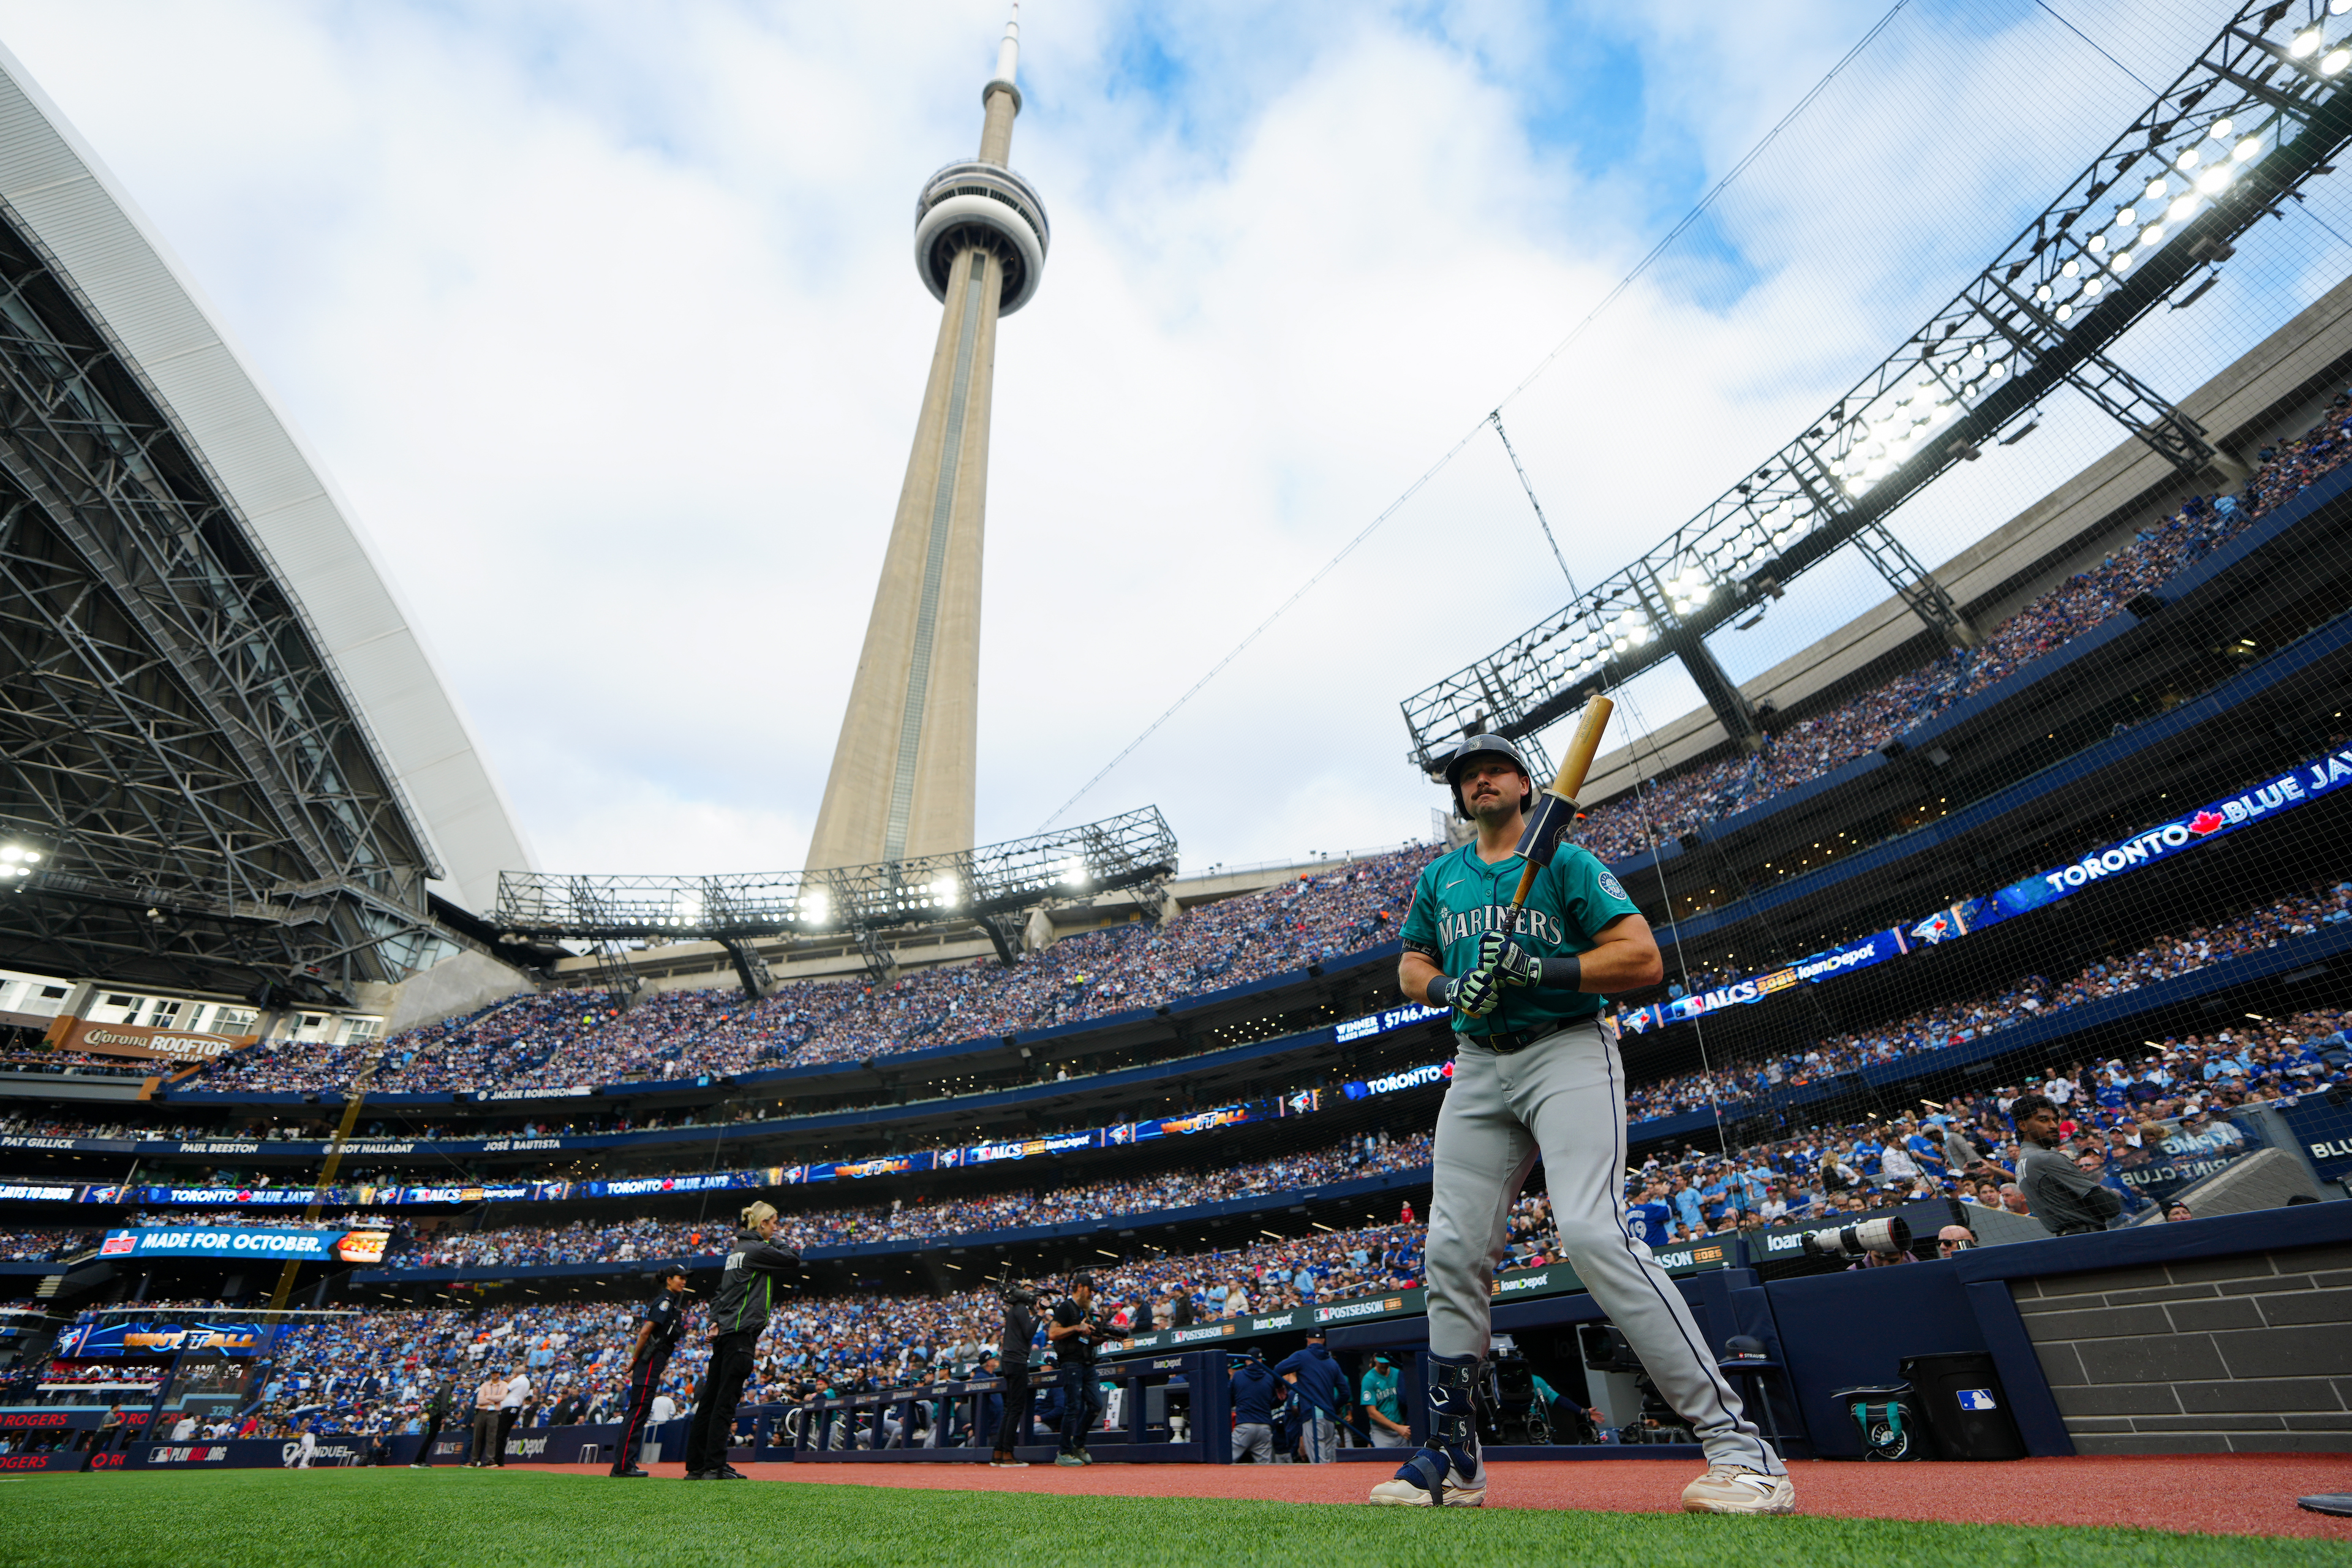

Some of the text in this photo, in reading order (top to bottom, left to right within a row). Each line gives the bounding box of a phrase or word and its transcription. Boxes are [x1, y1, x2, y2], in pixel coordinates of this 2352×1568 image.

[2046, 824, 2189, 893] TORONTO
[2222, 775, 2305, 824] BLUE
[1437, 904, 1563, 952] MARINERS
[1504, 944, 1518, 968] Franklin
[1705, 943, 1875, 1011] ALCS 2025 loanDepot
[1335, 1016, 1379, 1035] WINNER
[1336, 1025, 1379, 1043] TAKES HOME
[83, 1028, 149, 1047] Corona
[149, 1035, 231, 1057] ROOFTOP
[1366, 1066, 1441, 1095] TORONTO
[490, 1090, 524, 1101] JACKIE
[524, 1087, 572, 1099] ROBINSON
[1, 1136, 76, 1149] PAT GILLICK
[179, 1143, 258, 1153] PAUL BEESTON
[338, 1144, 360, 1153] ROY
[361, 1144, 415, 1154] HALLADAY
[483, 1139, 560, 1152] JOSÉ BAUTISTA
[989, 1143, 1022, 1159] ALCS
[1046, 1134, 1090, 1150] loanDepot
[607, 1175, 729, 1194] TORONTO BLUE JAYS
[171, 1189, 315, 1203] TORONTO BLUE JAYS
[429, 1188, 462, 1201] ALCS
[1629, 1220, 1647, 1240] 19
[140, 1233, 188, 1248] MADE
[191, 1233, 232, 1249] FOR
[233, 1234, 322, 1253] OCTOBER.
[1694, 1248, 1722, 1261] 2025
[1501, 1273, 1547, 1292] loanDepot
[1329, 1299, 1403, 1319] POSTSEASON 2025
[1253, 1313, 1293, 1330] loanDepot
[124, 1333, 182, 1347] WANT
[202, 1333, 257, 1347] ALL
[1182, 1326, 1223, 1341] POSTSEASON
[1108, 1341, 1123, 1352] ALCS
[1134, 1335, 1158, 1346] loanDepot
[1153, 1357, 1183, 1370] loanDepot
[4, 1414, 69, 1426] ROGERS
[209, 1406, 234, 1417] 328
[169, 1446, 227, 1462] PLAYBALL.ORG
